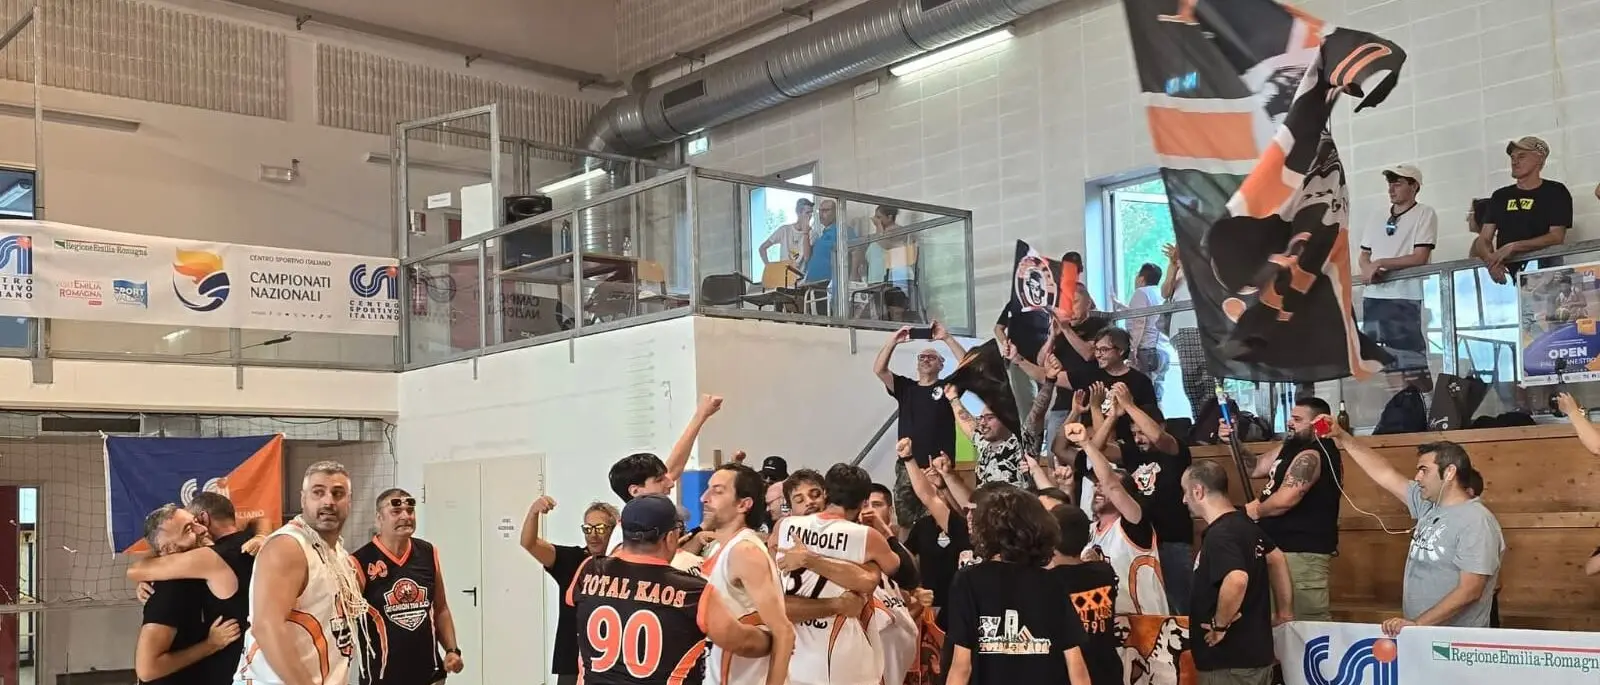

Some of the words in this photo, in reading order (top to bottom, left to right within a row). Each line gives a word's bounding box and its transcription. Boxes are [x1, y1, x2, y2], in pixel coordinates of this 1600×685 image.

[250, 254, 274, 263] CENTRO
[275, 256, 304, 265] SPORTIVO
[305, 258, 332, 267] ITALIANO
[249, 271, 331, 289] CAMPIONATI
[350, 263, 399, 300] CSI
[114, 286, 145, 296] SPORT
[249, 286, 322, 303] NAZIONALI
[349, 300, 399, 309] CENTRO
[349, 306, 399, 315] SPORTIVO
[349, 312, 399, 321] ITALIANO
[1548, 346, 1588, 360] OPEN
[581, 574, 632, 600] TOTAL
[633, 580, 688, 608] KAOS
[586, 604, 664, 679] 90
[1303, 635, 1399, 685] CSI
